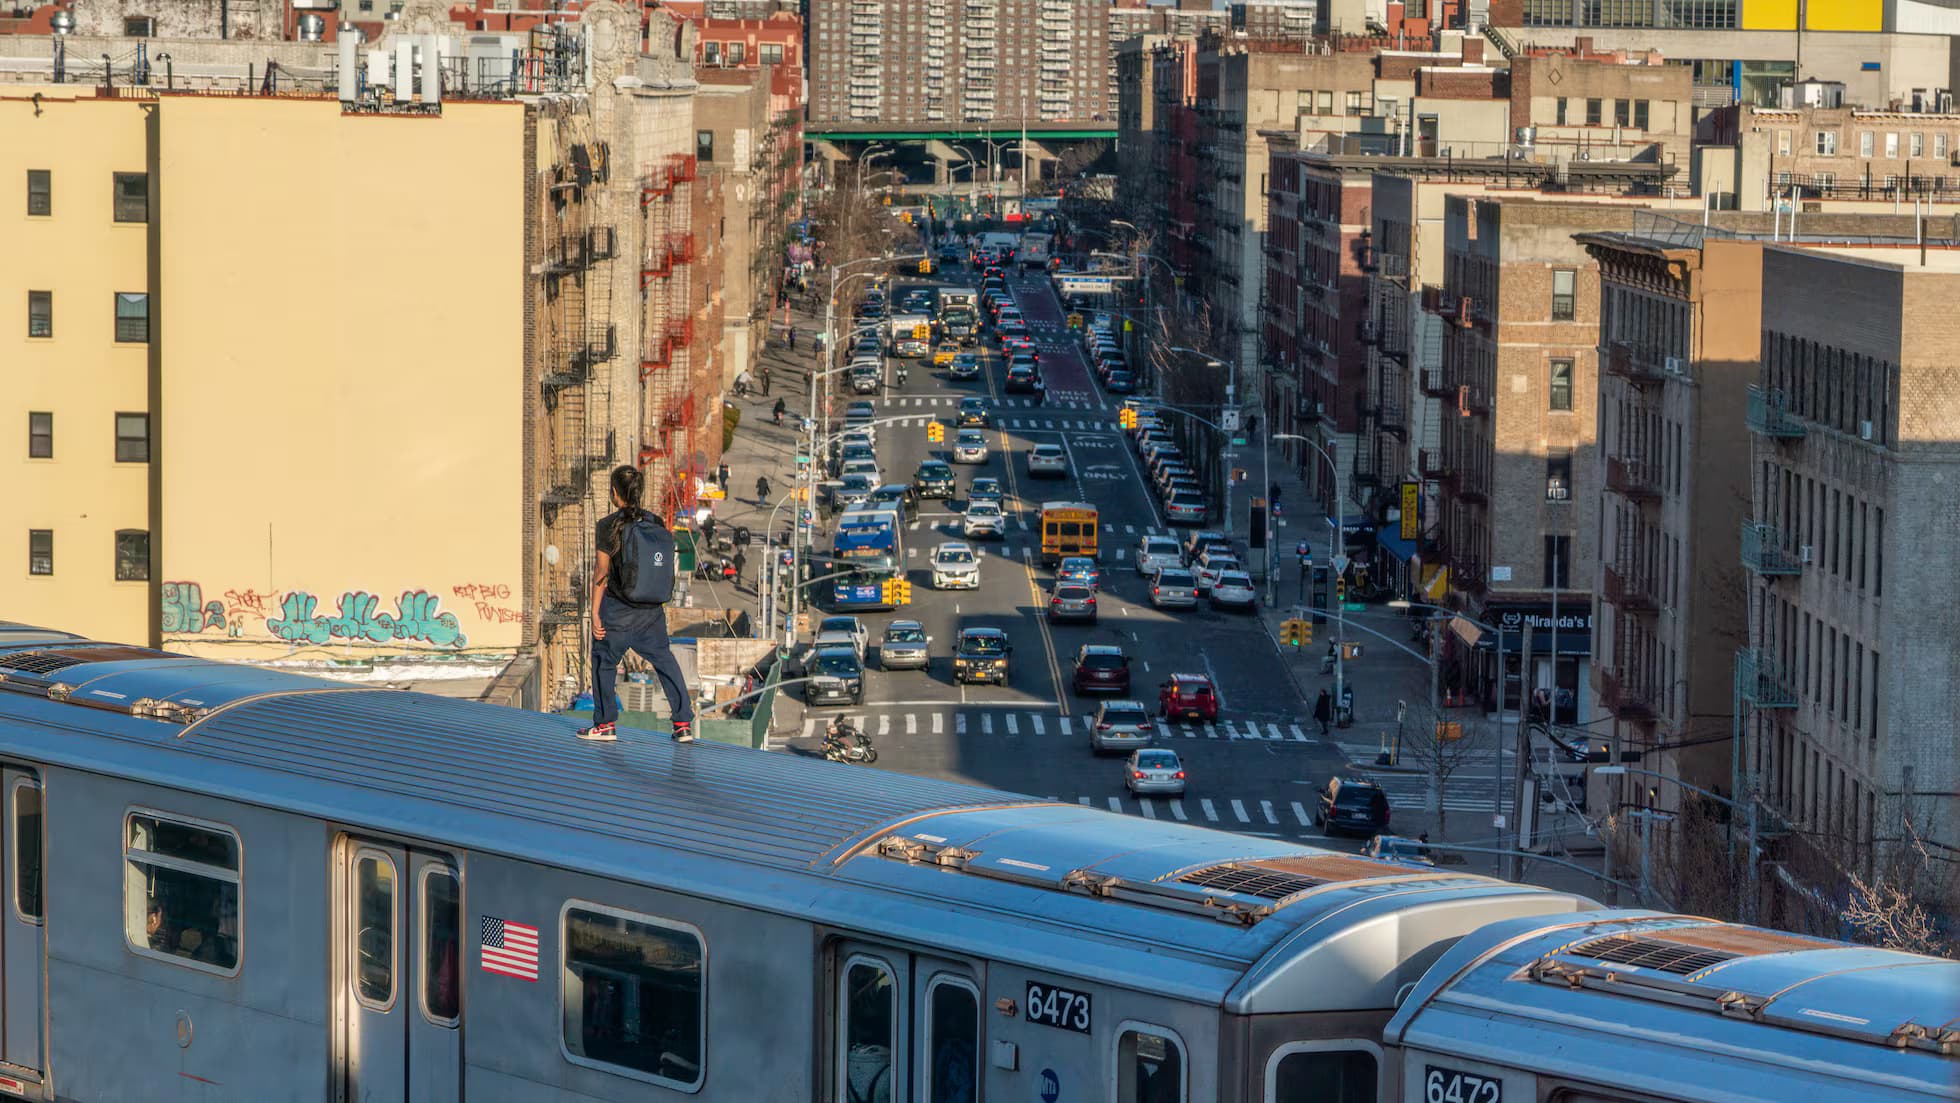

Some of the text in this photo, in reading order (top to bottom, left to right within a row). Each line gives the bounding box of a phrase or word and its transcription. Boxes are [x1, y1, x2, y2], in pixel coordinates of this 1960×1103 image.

[1084, 472, 1128, 480] ONLY
[453, 584, 510, 600] RIP BIG
[1525, 614, 1584, 628] Miranda's
[1028, 985, 1089, 1030] 6473
[1427, 1070, 1499, 1103] 6472
